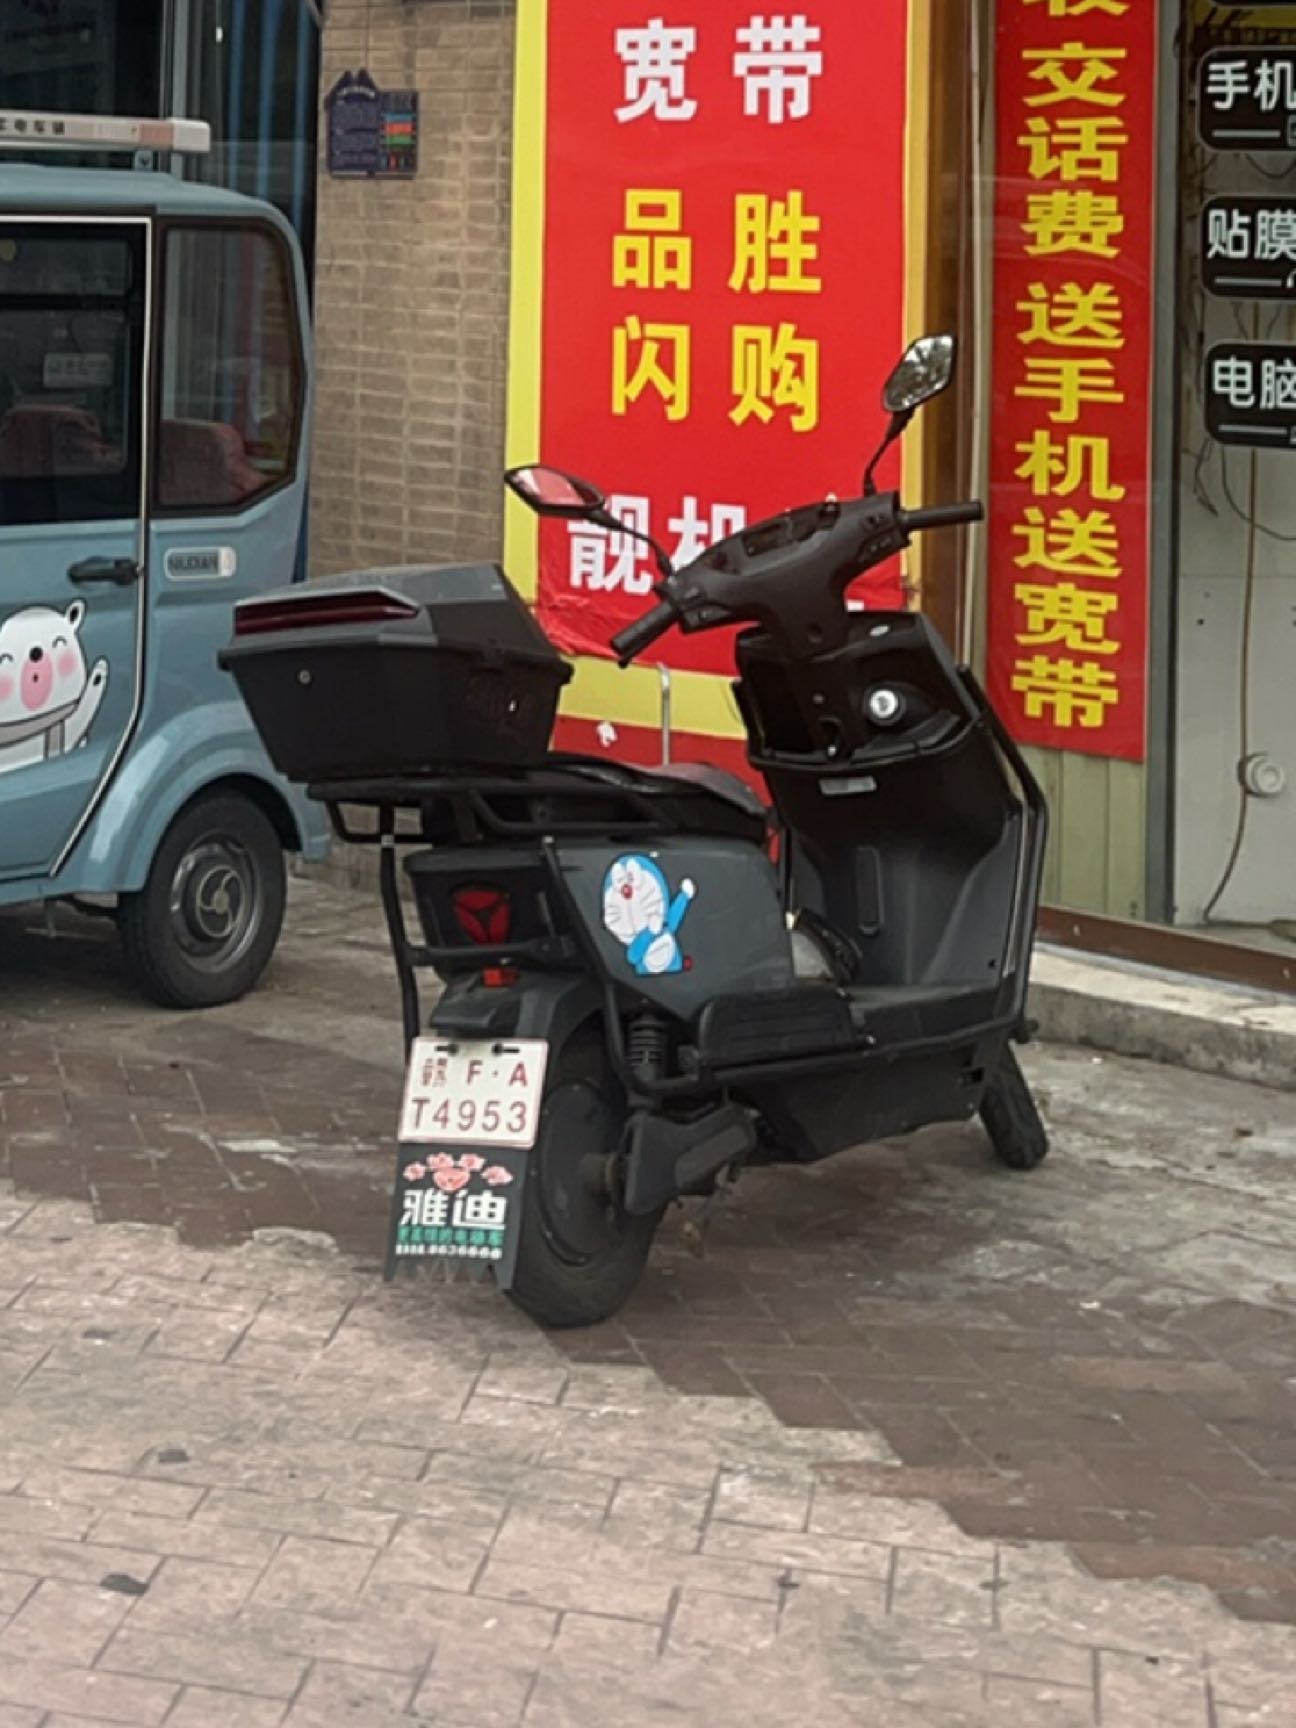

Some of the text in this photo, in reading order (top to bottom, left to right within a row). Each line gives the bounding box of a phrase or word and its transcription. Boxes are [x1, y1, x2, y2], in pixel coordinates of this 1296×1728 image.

[613, 15, 824, 124] 宽带
[1206, 58, 1296, 112] 手机
[1015, 40, 1129, 259] 交话费
[612, 188, 822, 294] 品胜
[1207, 208, 1296, 260] 贴膜
[611, 315, 820, 432] 闪购
[1212, 355, 1296, 410] 电脑
[1011, 281, 1125, 728] 送手机送宽带
[411, 1096, 527, 1133] T4953
[400, 1188, 507, 1230] 雅迪
